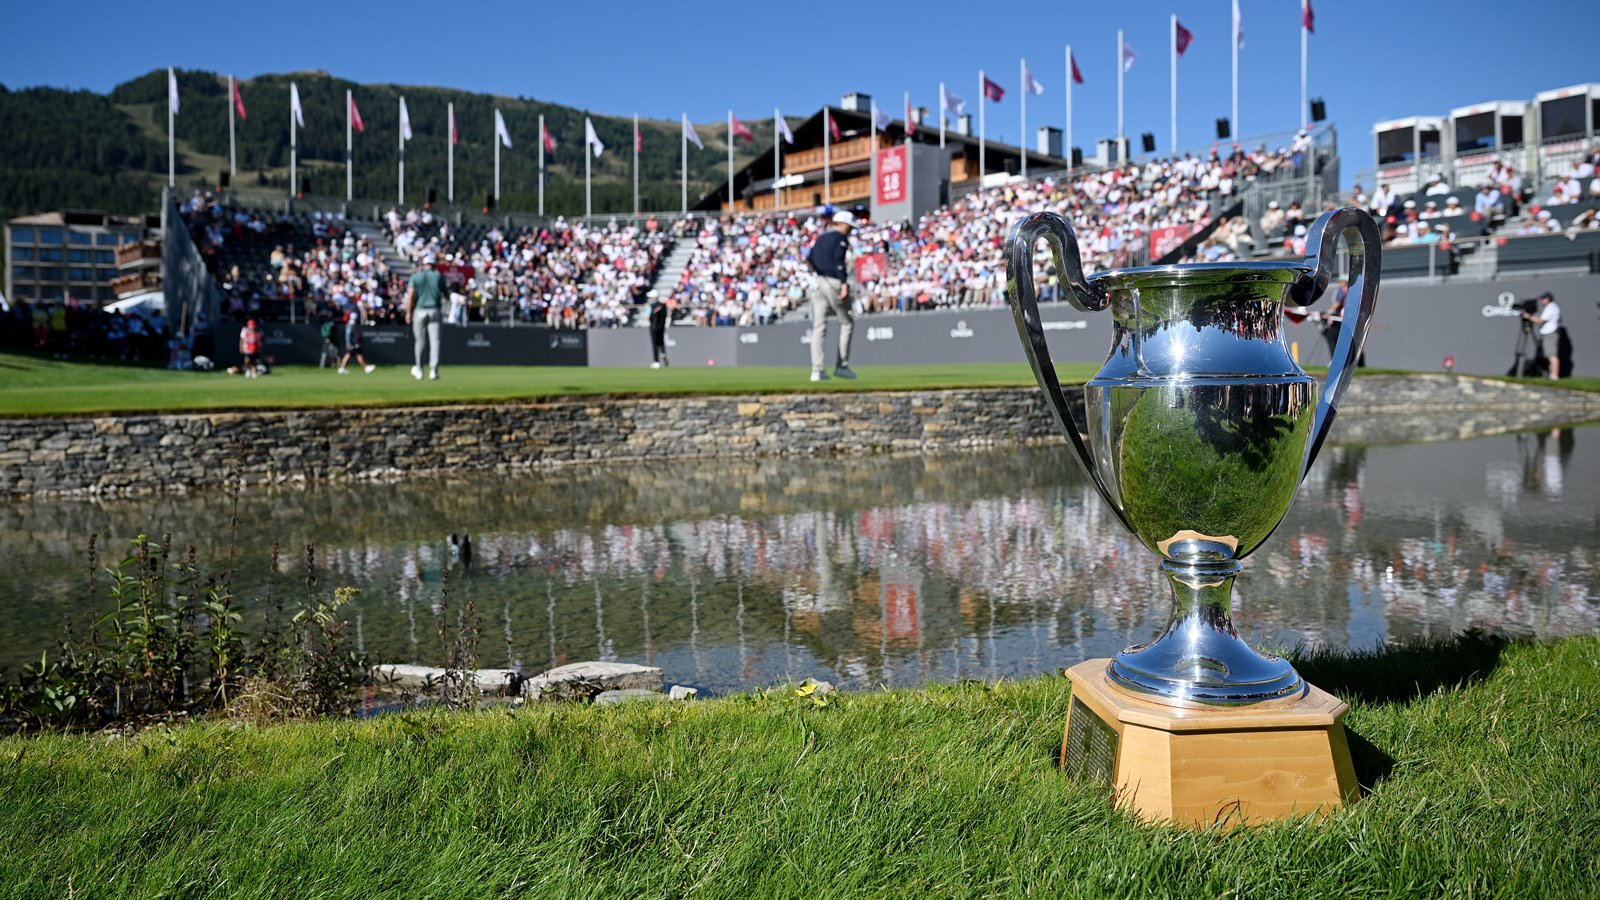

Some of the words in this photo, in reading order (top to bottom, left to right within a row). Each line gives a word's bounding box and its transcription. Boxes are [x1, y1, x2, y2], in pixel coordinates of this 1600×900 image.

[883, 172, 900, 192] 18
[1481, 305, 1523, 317] OMEG
[875, 326, 894, 340] UBS
